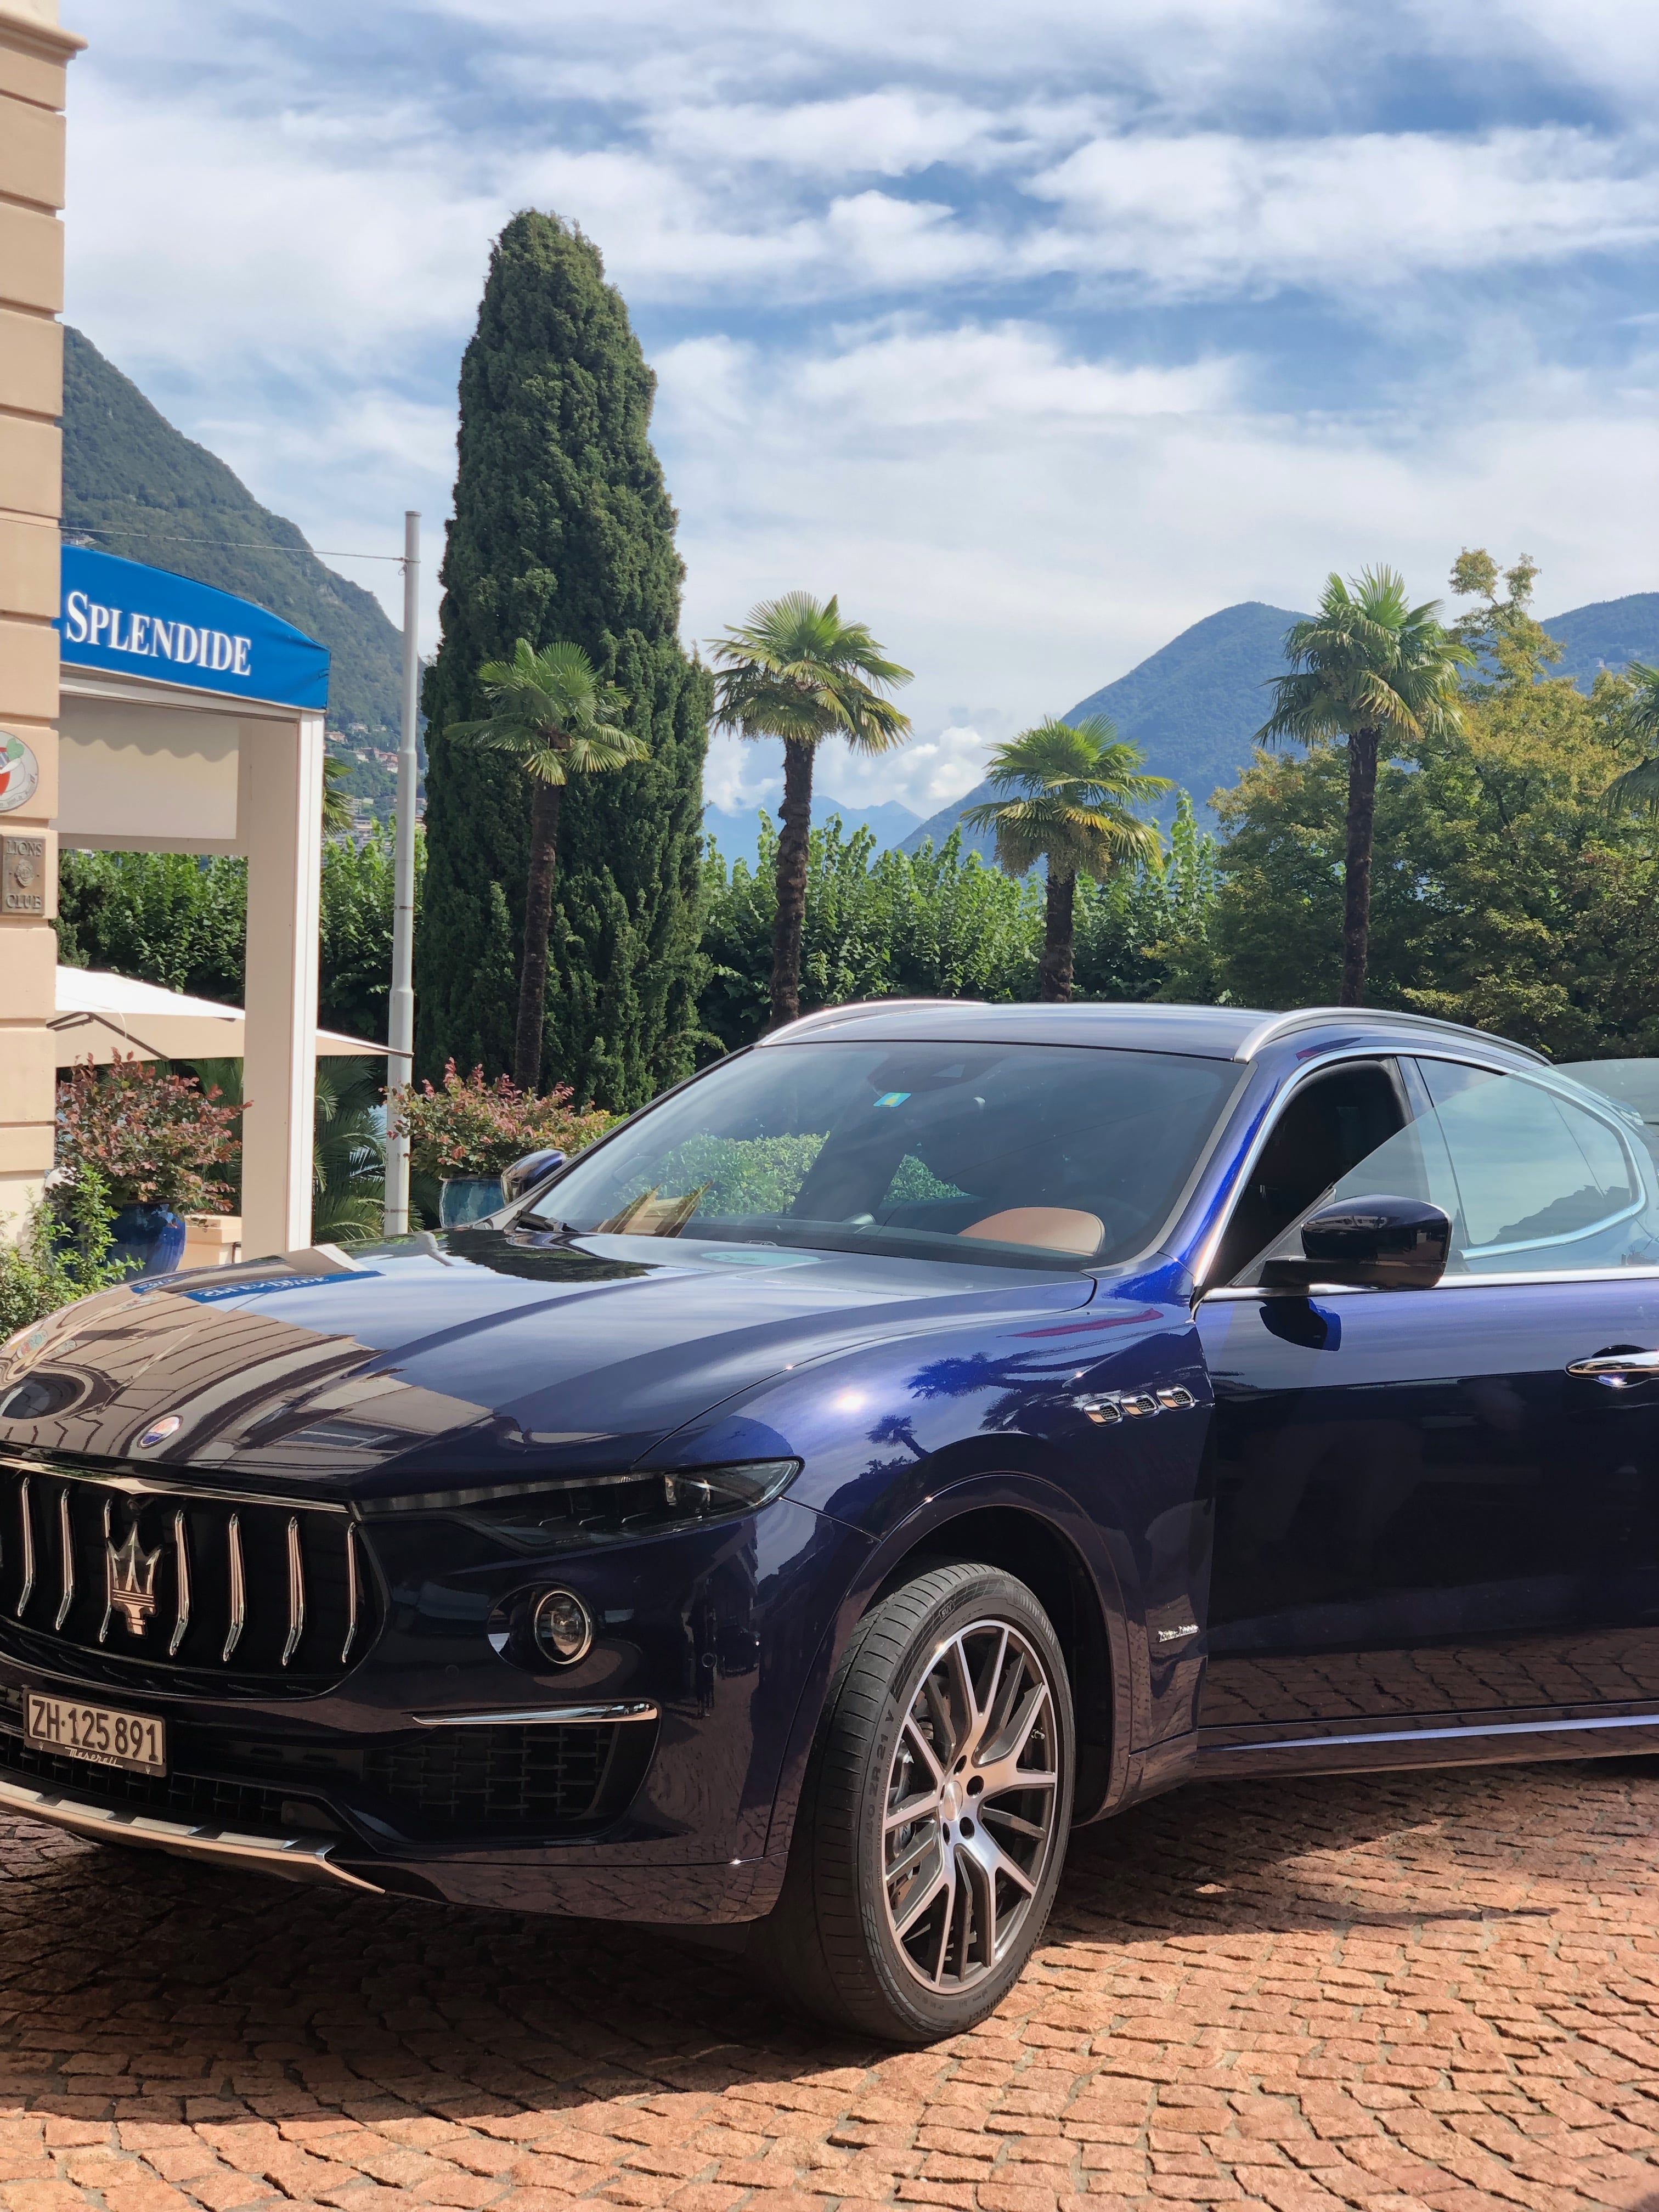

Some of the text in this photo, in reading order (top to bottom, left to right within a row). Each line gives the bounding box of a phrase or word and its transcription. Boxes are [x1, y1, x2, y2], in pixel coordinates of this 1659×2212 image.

[66, 591, 252, 676] SPLENDIDE
[7, 840, 42, 856] LIONS
[7, 895, 41, 909] CLUB
[941, 1602, 952, 1618] SUV
[65, 1747, 123, 1768] Maserati
[868, 1765, 881, 1796] ZR
[876, 1733, 888, 1759] 21
[885, 1709, 894, 1722] Y
